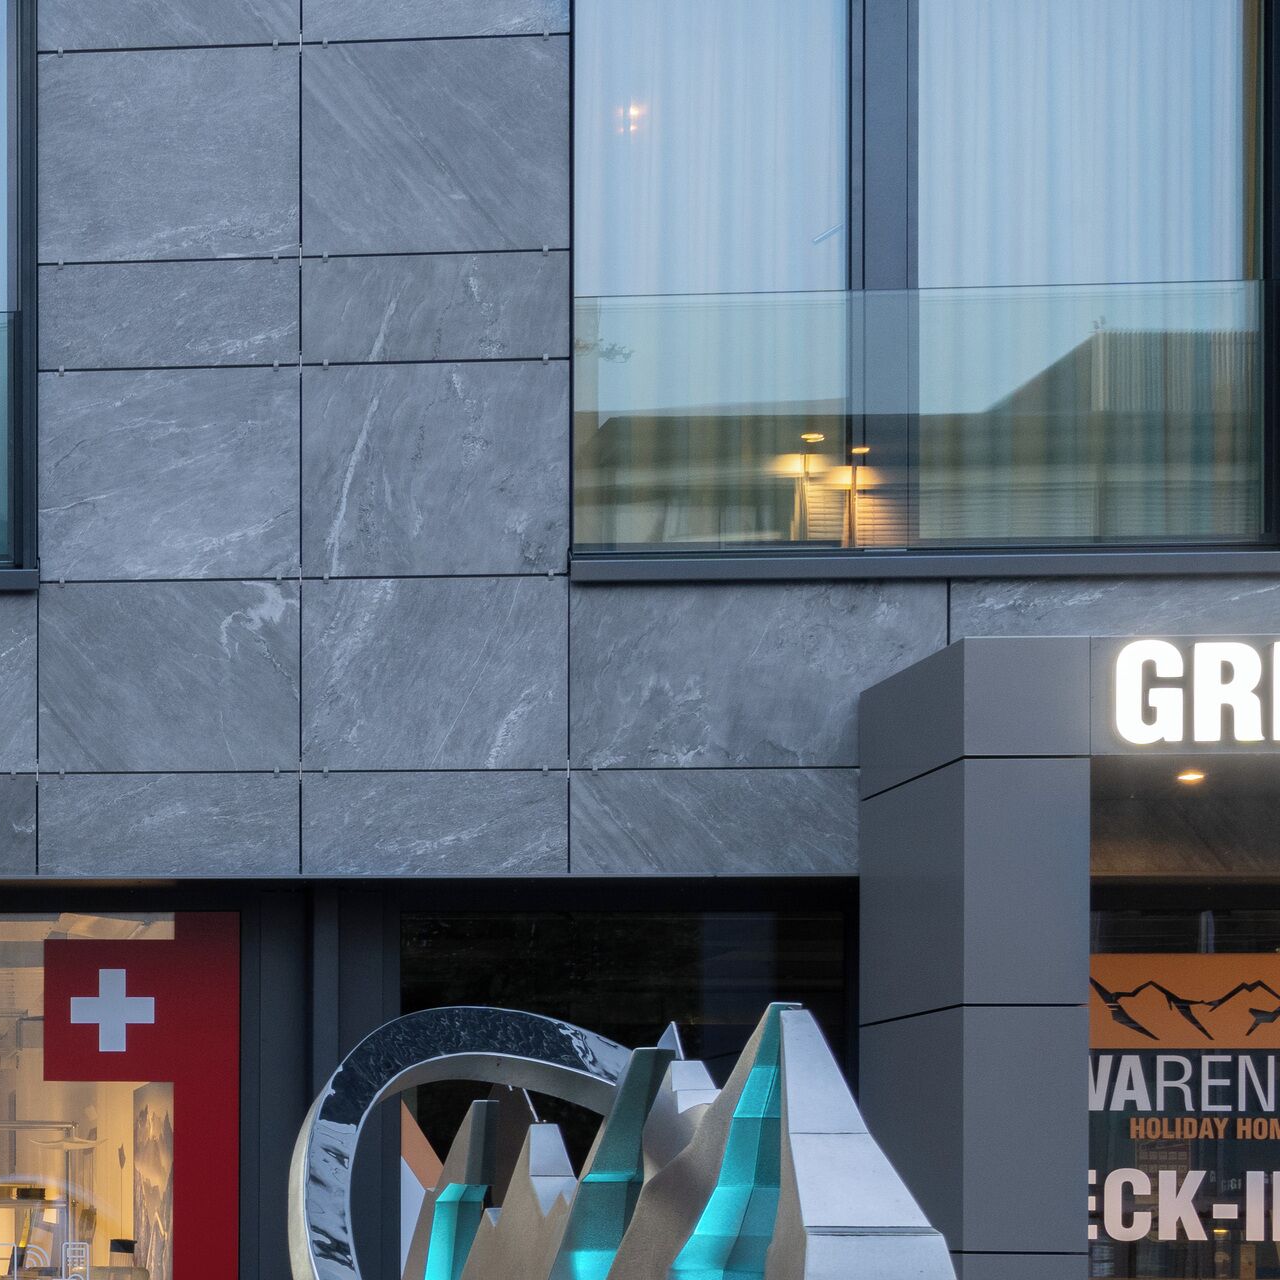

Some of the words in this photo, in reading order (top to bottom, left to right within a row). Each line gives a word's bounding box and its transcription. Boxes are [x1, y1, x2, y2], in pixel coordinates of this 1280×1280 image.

[1116, 639, 1280, 745] GR
[1130, 1117, 1229, 1139] HOLIDAY
[1236, 1117, 1280, 1140] HO
